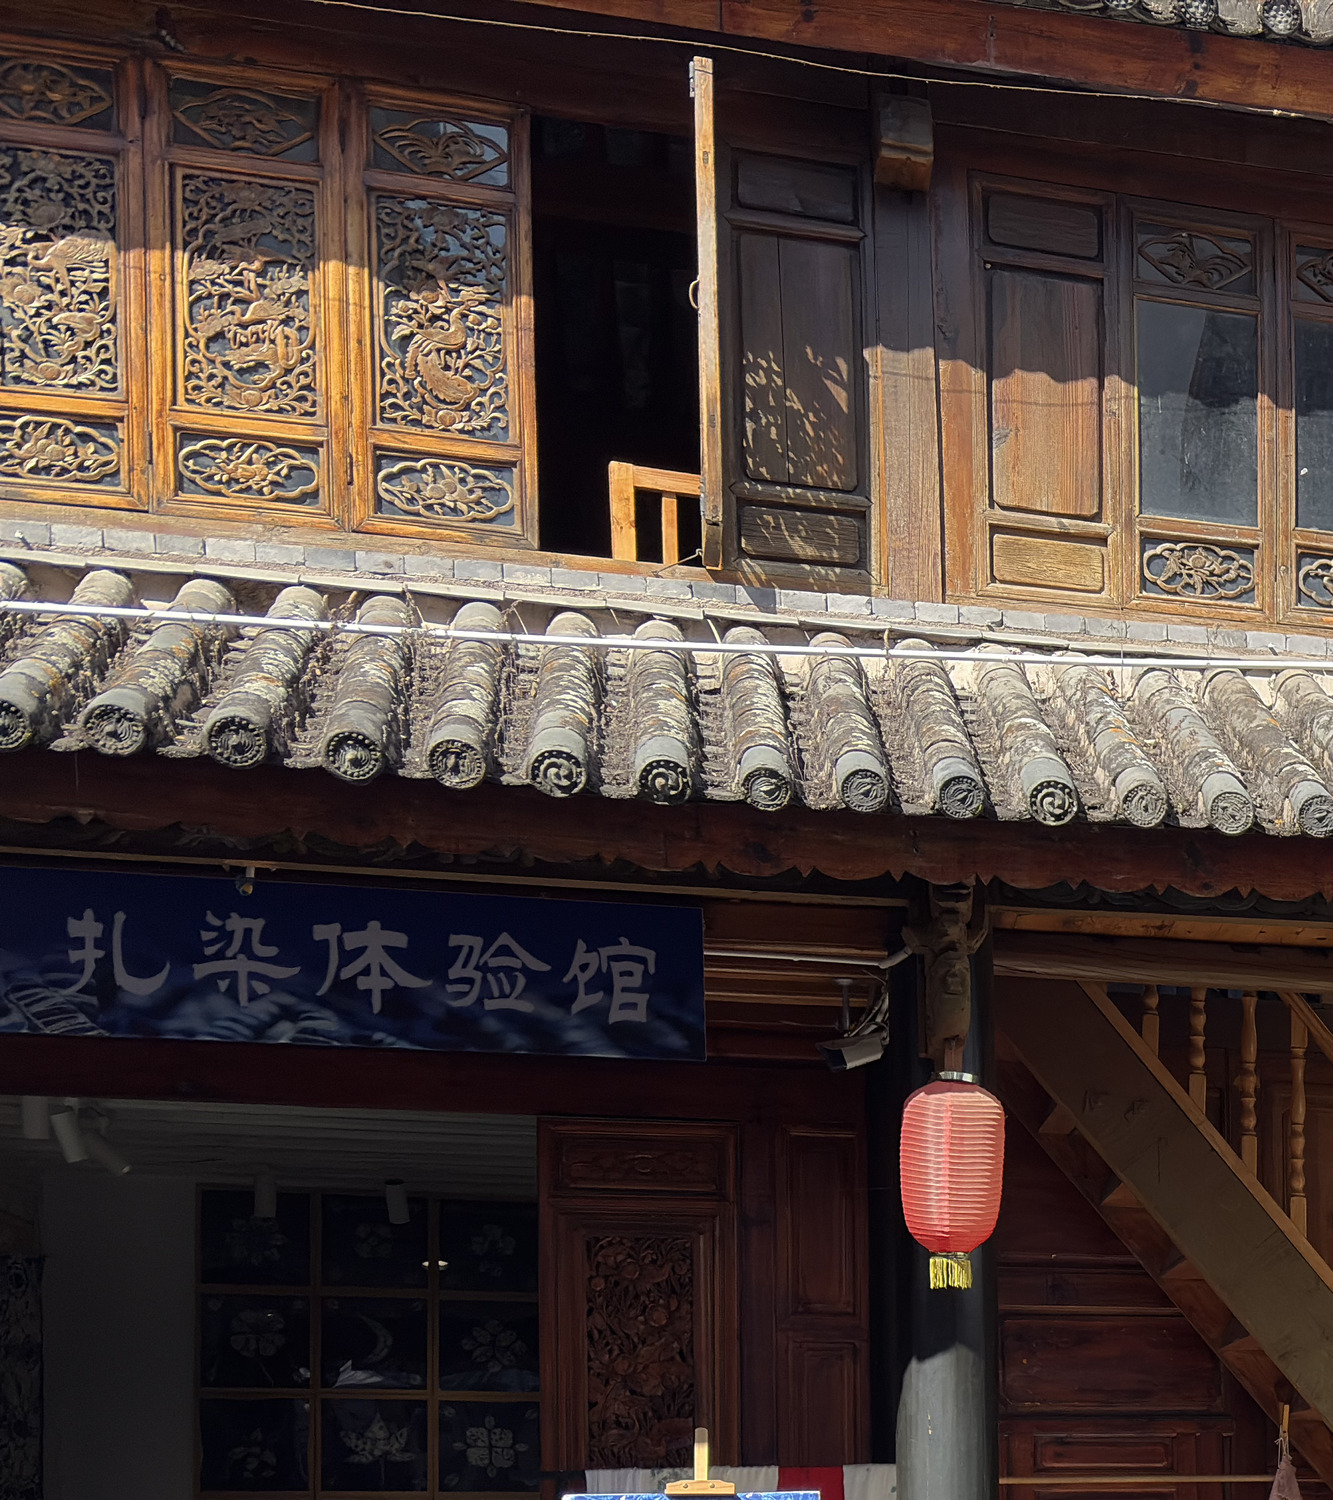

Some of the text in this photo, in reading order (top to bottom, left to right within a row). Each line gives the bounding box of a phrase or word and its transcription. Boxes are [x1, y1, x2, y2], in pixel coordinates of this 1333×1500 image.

[62, 908, 658, 1024] 扎染体验馆
